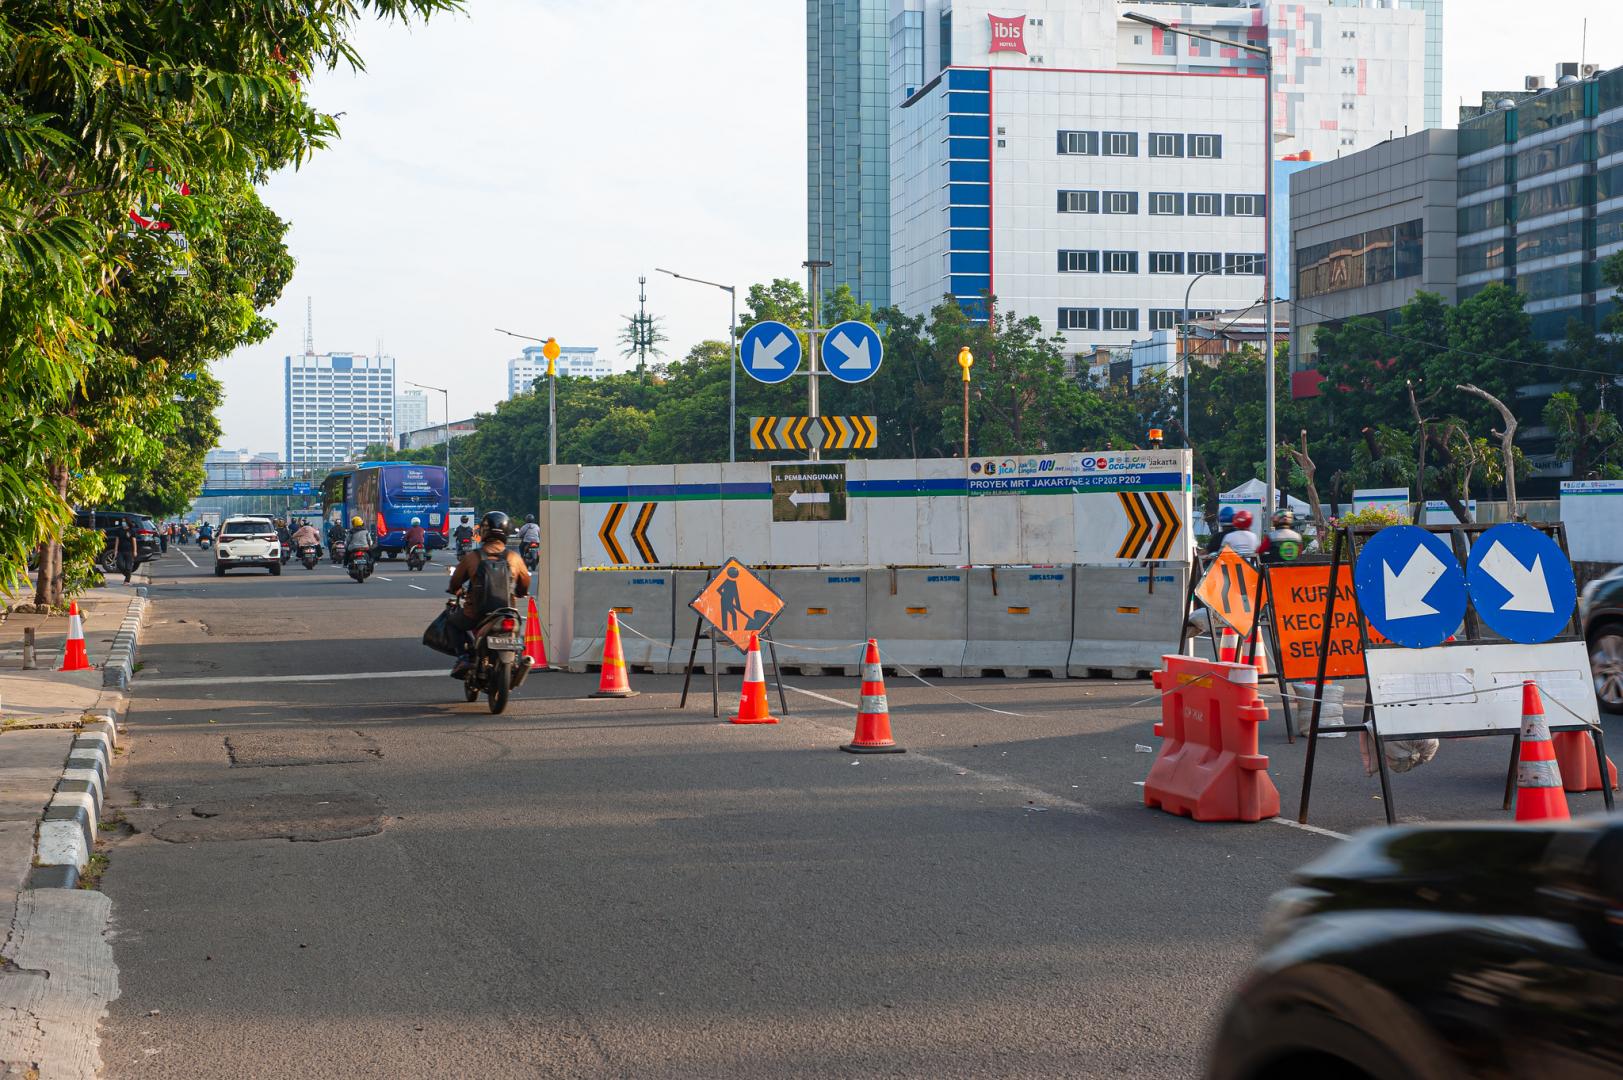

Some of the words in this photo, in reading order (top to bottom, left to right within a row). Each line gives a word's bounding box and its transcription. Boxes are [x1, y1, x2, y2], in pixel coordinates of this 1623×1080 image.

[994, 22, 1021, 38] ibis
[784, 473, 839, 481] PEMBANGUNAN
[970, 480, 1008, 489] PROYEK
[1010, 479, 1029, 488] MRT
[1118, 475, 1141, 484] P202
